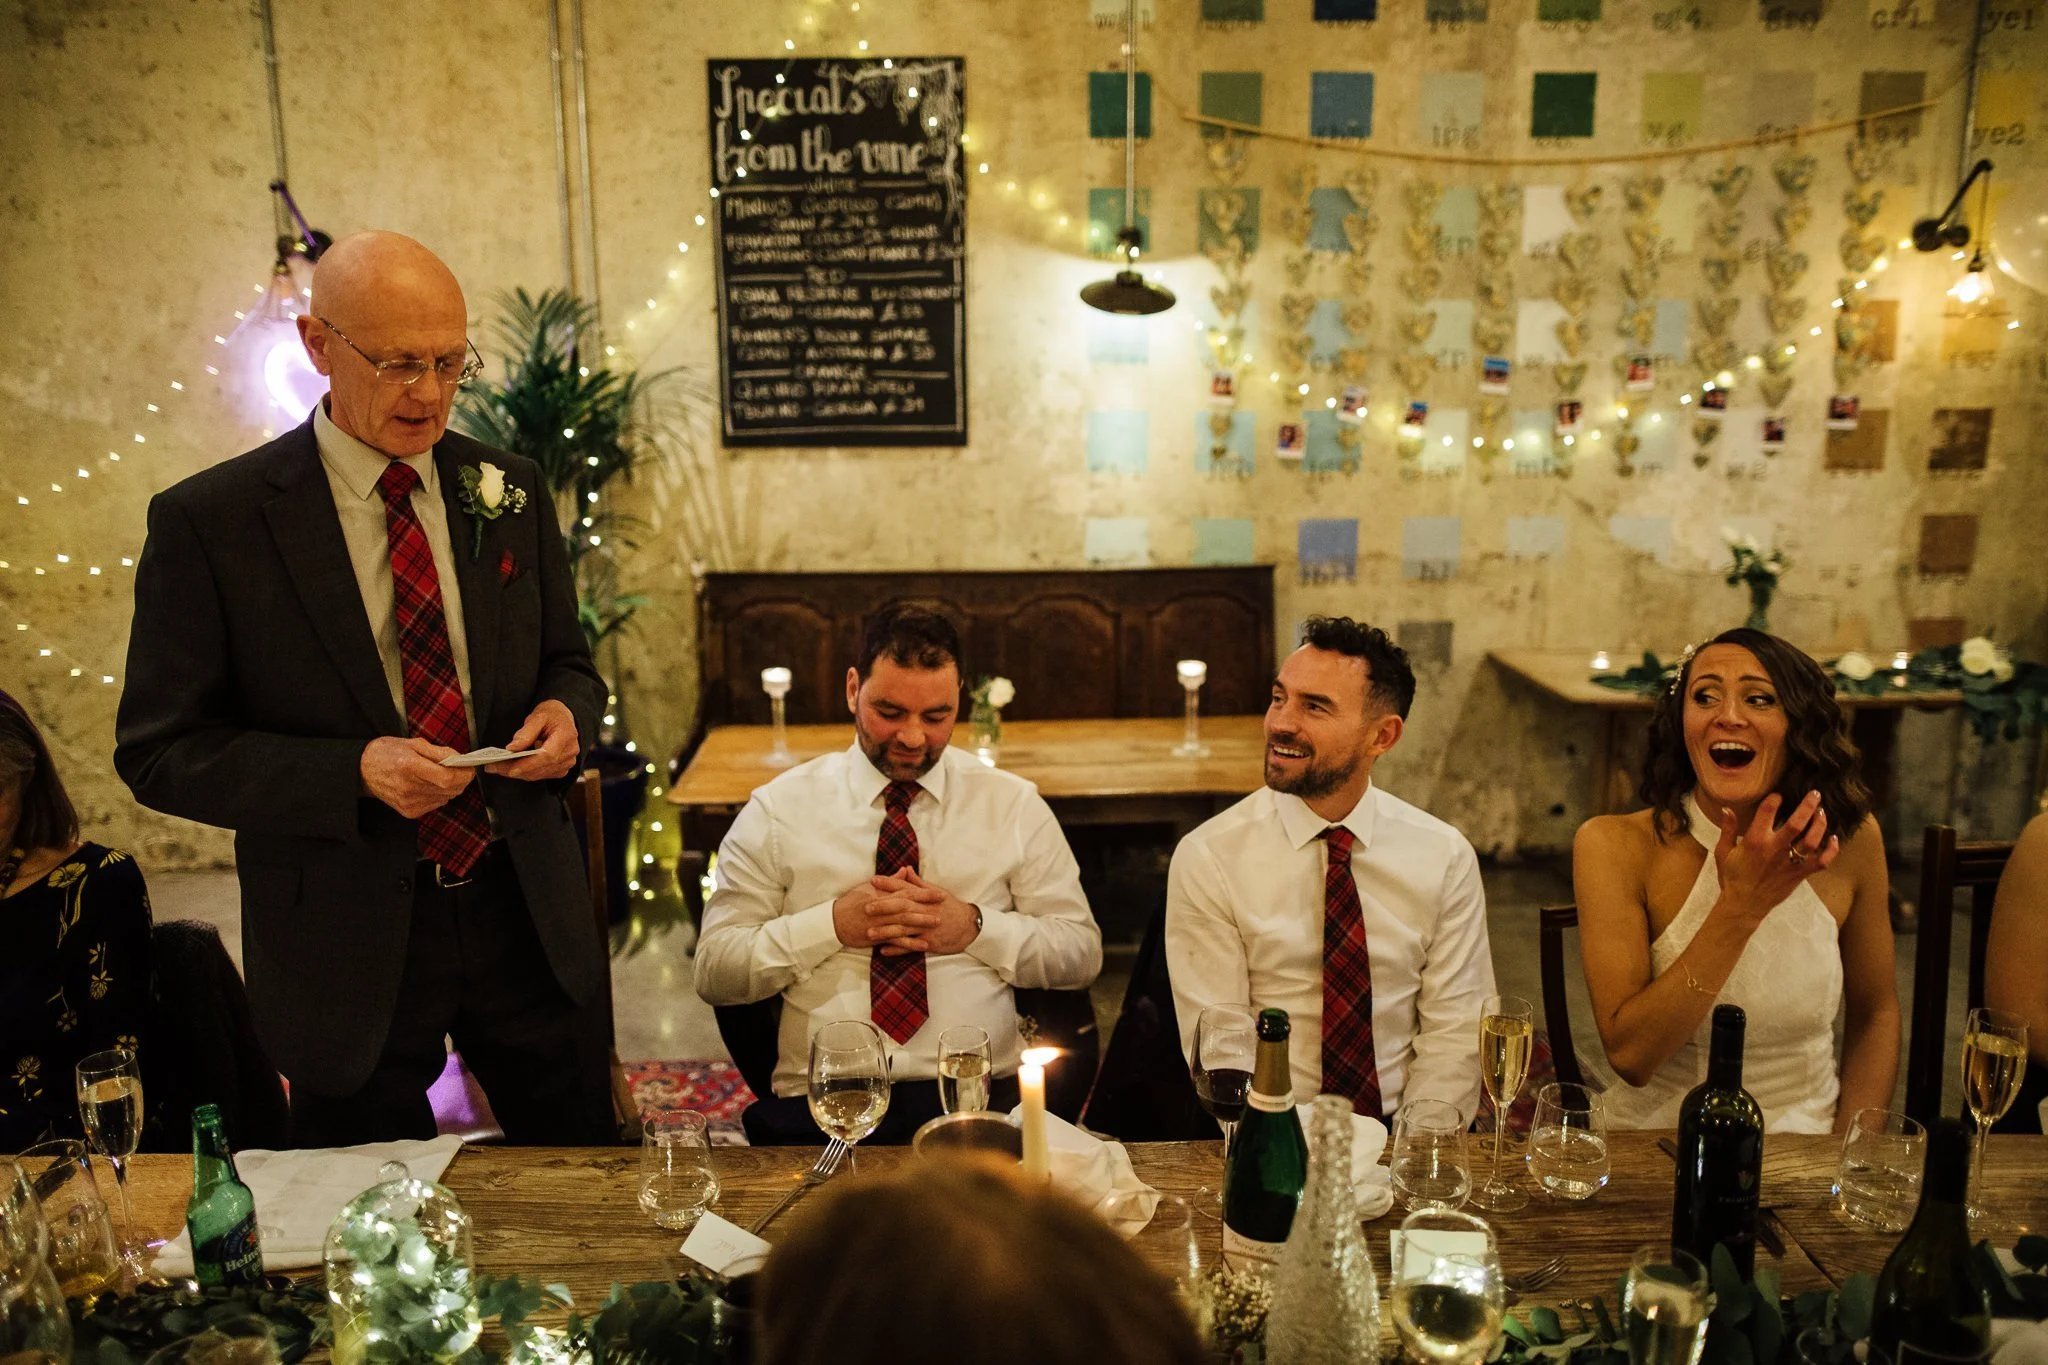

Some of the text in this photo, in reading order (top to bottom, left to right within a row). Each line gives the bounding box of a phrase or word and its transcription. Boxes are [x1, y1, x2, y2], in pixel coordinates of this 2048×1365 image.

[713, 62, 867, 138] Specials
[715, 119, 928, 184] from the vine
